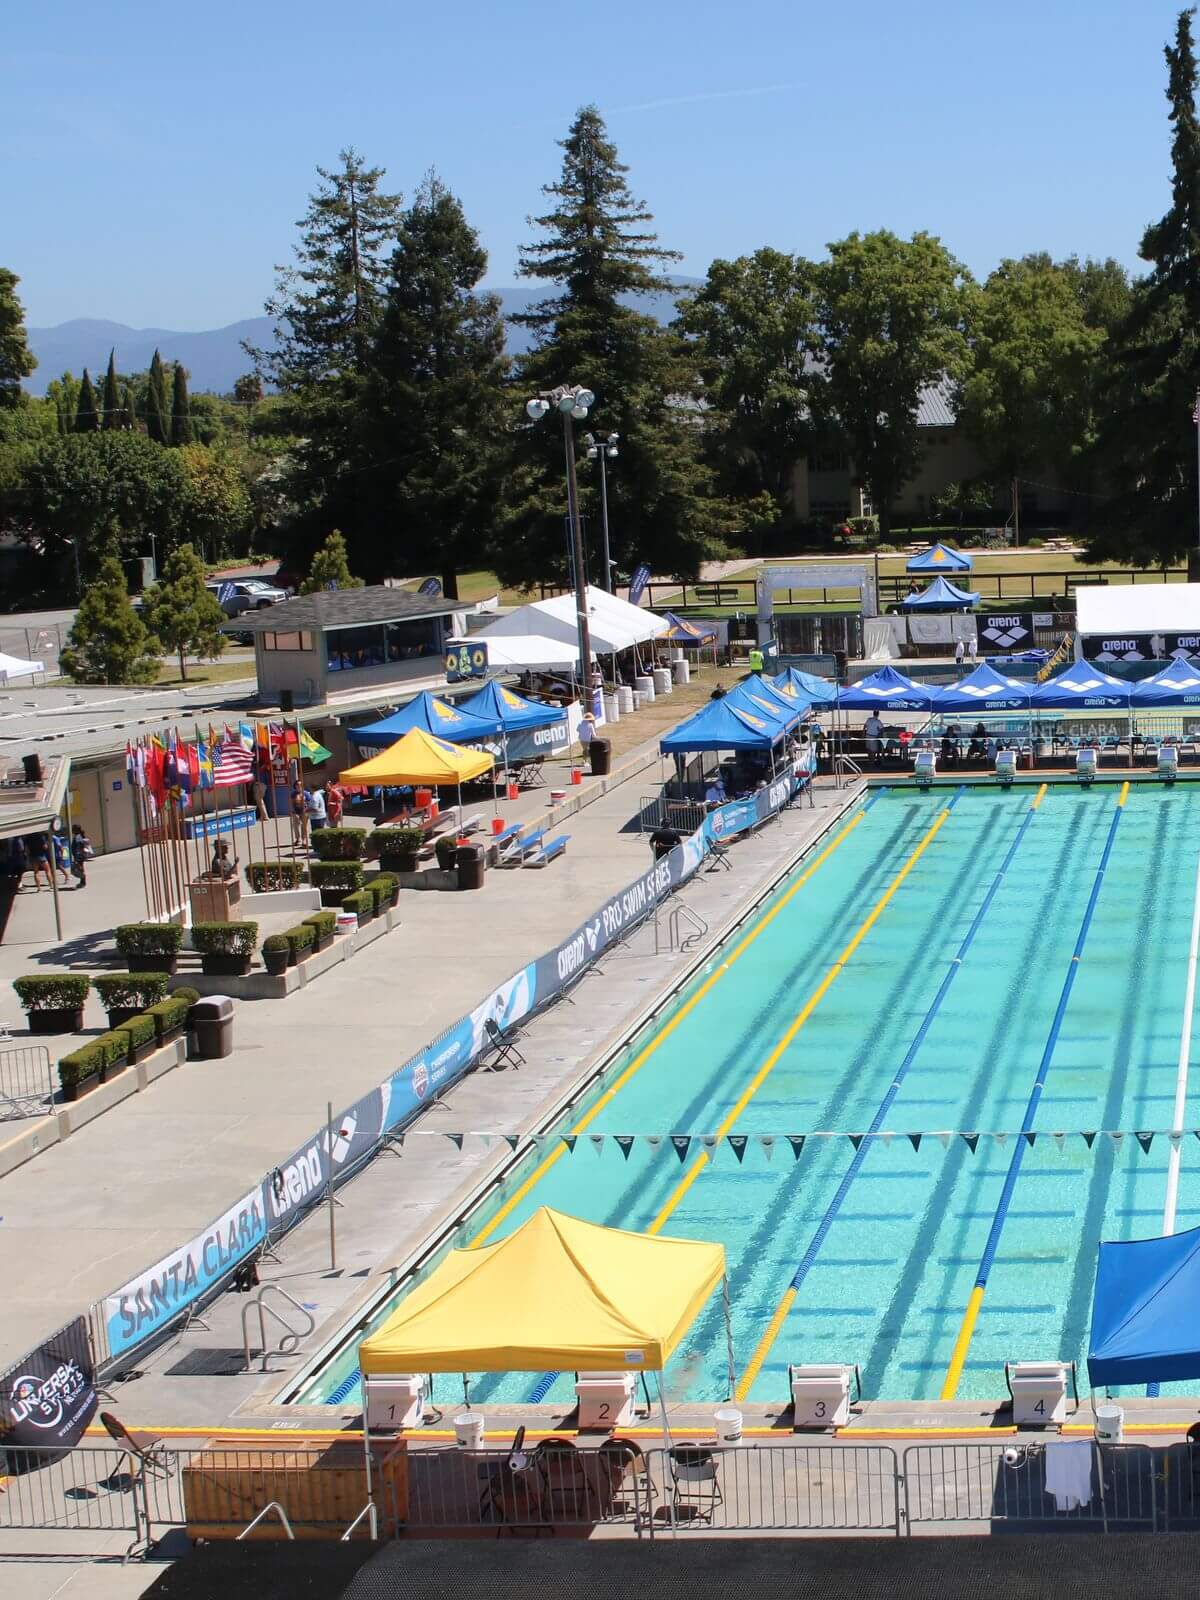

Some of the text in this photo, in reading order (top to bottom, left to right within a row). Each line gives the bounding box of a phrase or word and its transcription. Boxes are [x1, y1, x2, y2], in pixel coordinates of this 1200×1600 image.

[988, 615, 1020, 627] arena
[1102, 640, 1136, 651] arena
[534, 724, 566, 747] arena
[1069, 722, 1120, 736] CLARA
[557, 860, 671, 980] arena PRO SWIM SERIES
[119, 1199, 263, 1339] SANTA CLARA
[388, 1404, 396, 1419] 1
[599, 1403, 611, 1419] 2
[815, 1401, 826, 1417] 3
[1033, 1399, 1046, 1415] 4
